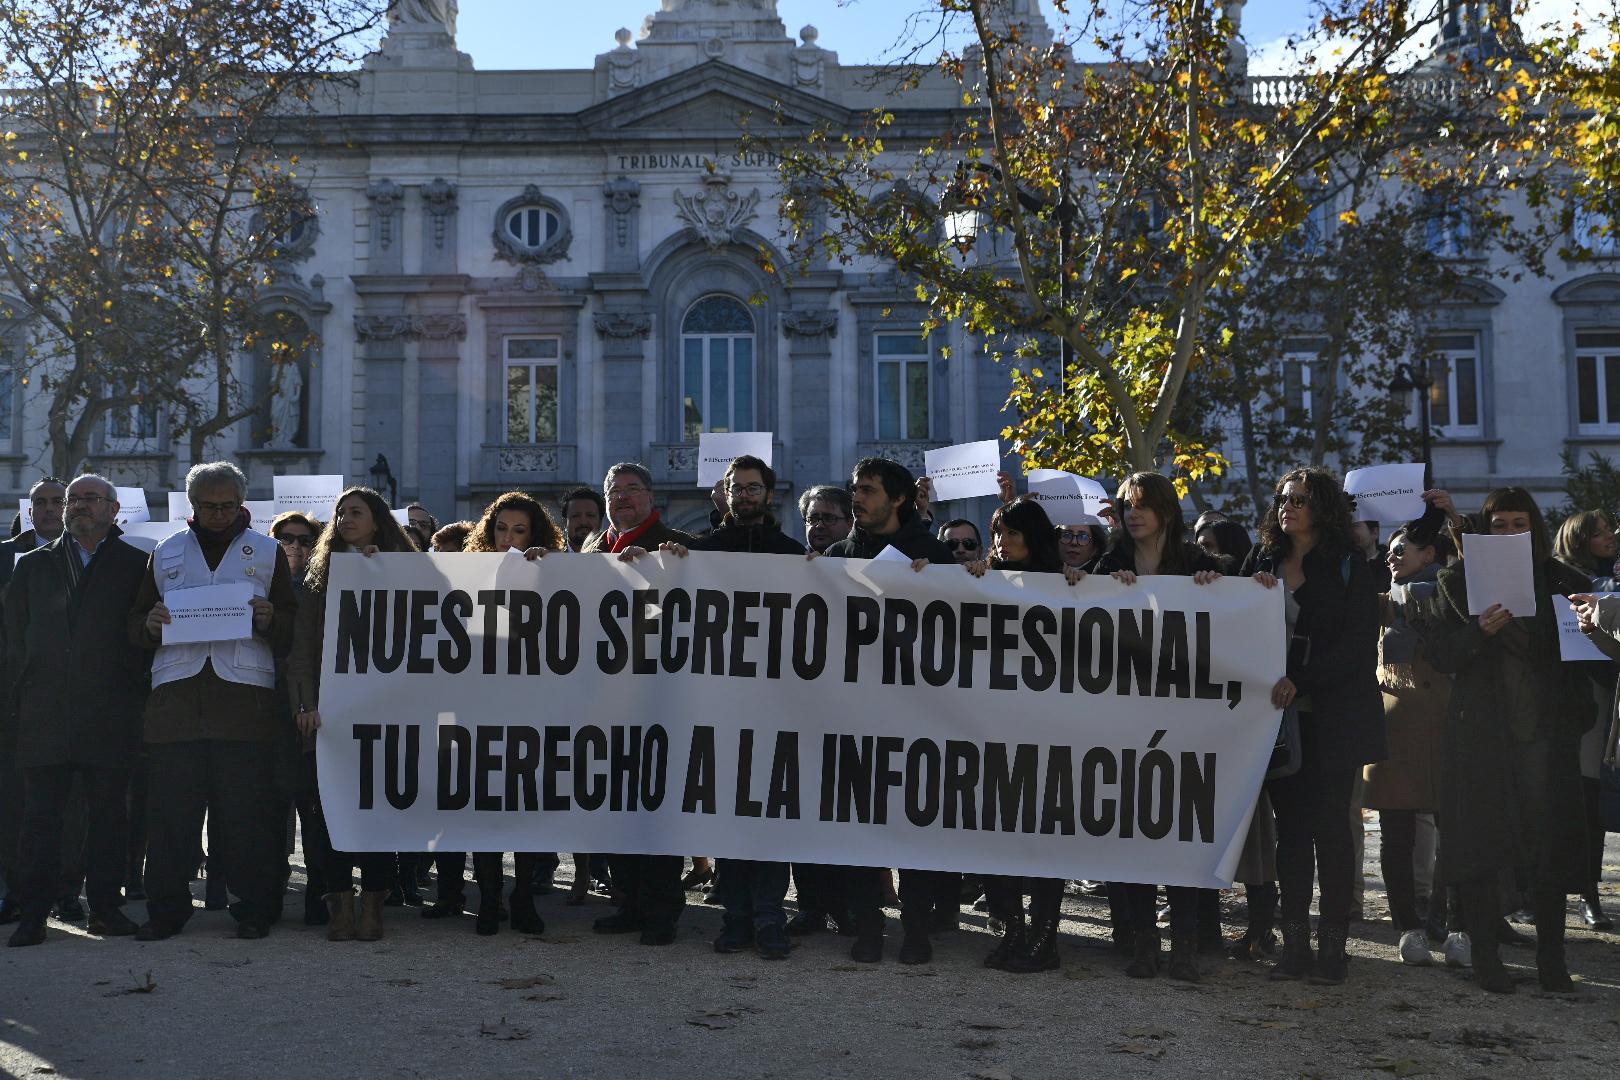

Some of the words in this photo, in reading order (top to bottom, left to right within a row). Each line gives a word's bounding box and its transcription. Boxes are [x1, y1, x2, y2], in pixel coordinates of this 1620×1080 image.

[617, 154, 705, 169] TRIBUNAL
[335, 589, 580, 676] NUESTRO
[597, 588, 829, 681] SECRETO
[844, 596, 1242, 710] PROFESIONAL,
[353, 724, 420, 811] TU
[437, 723, 669, 813] DERECHO
[682, 725, 717, 815] A
[735, 729, 801, 820] LA
[819, 730, 1217, 844] INFORMACIÓN
